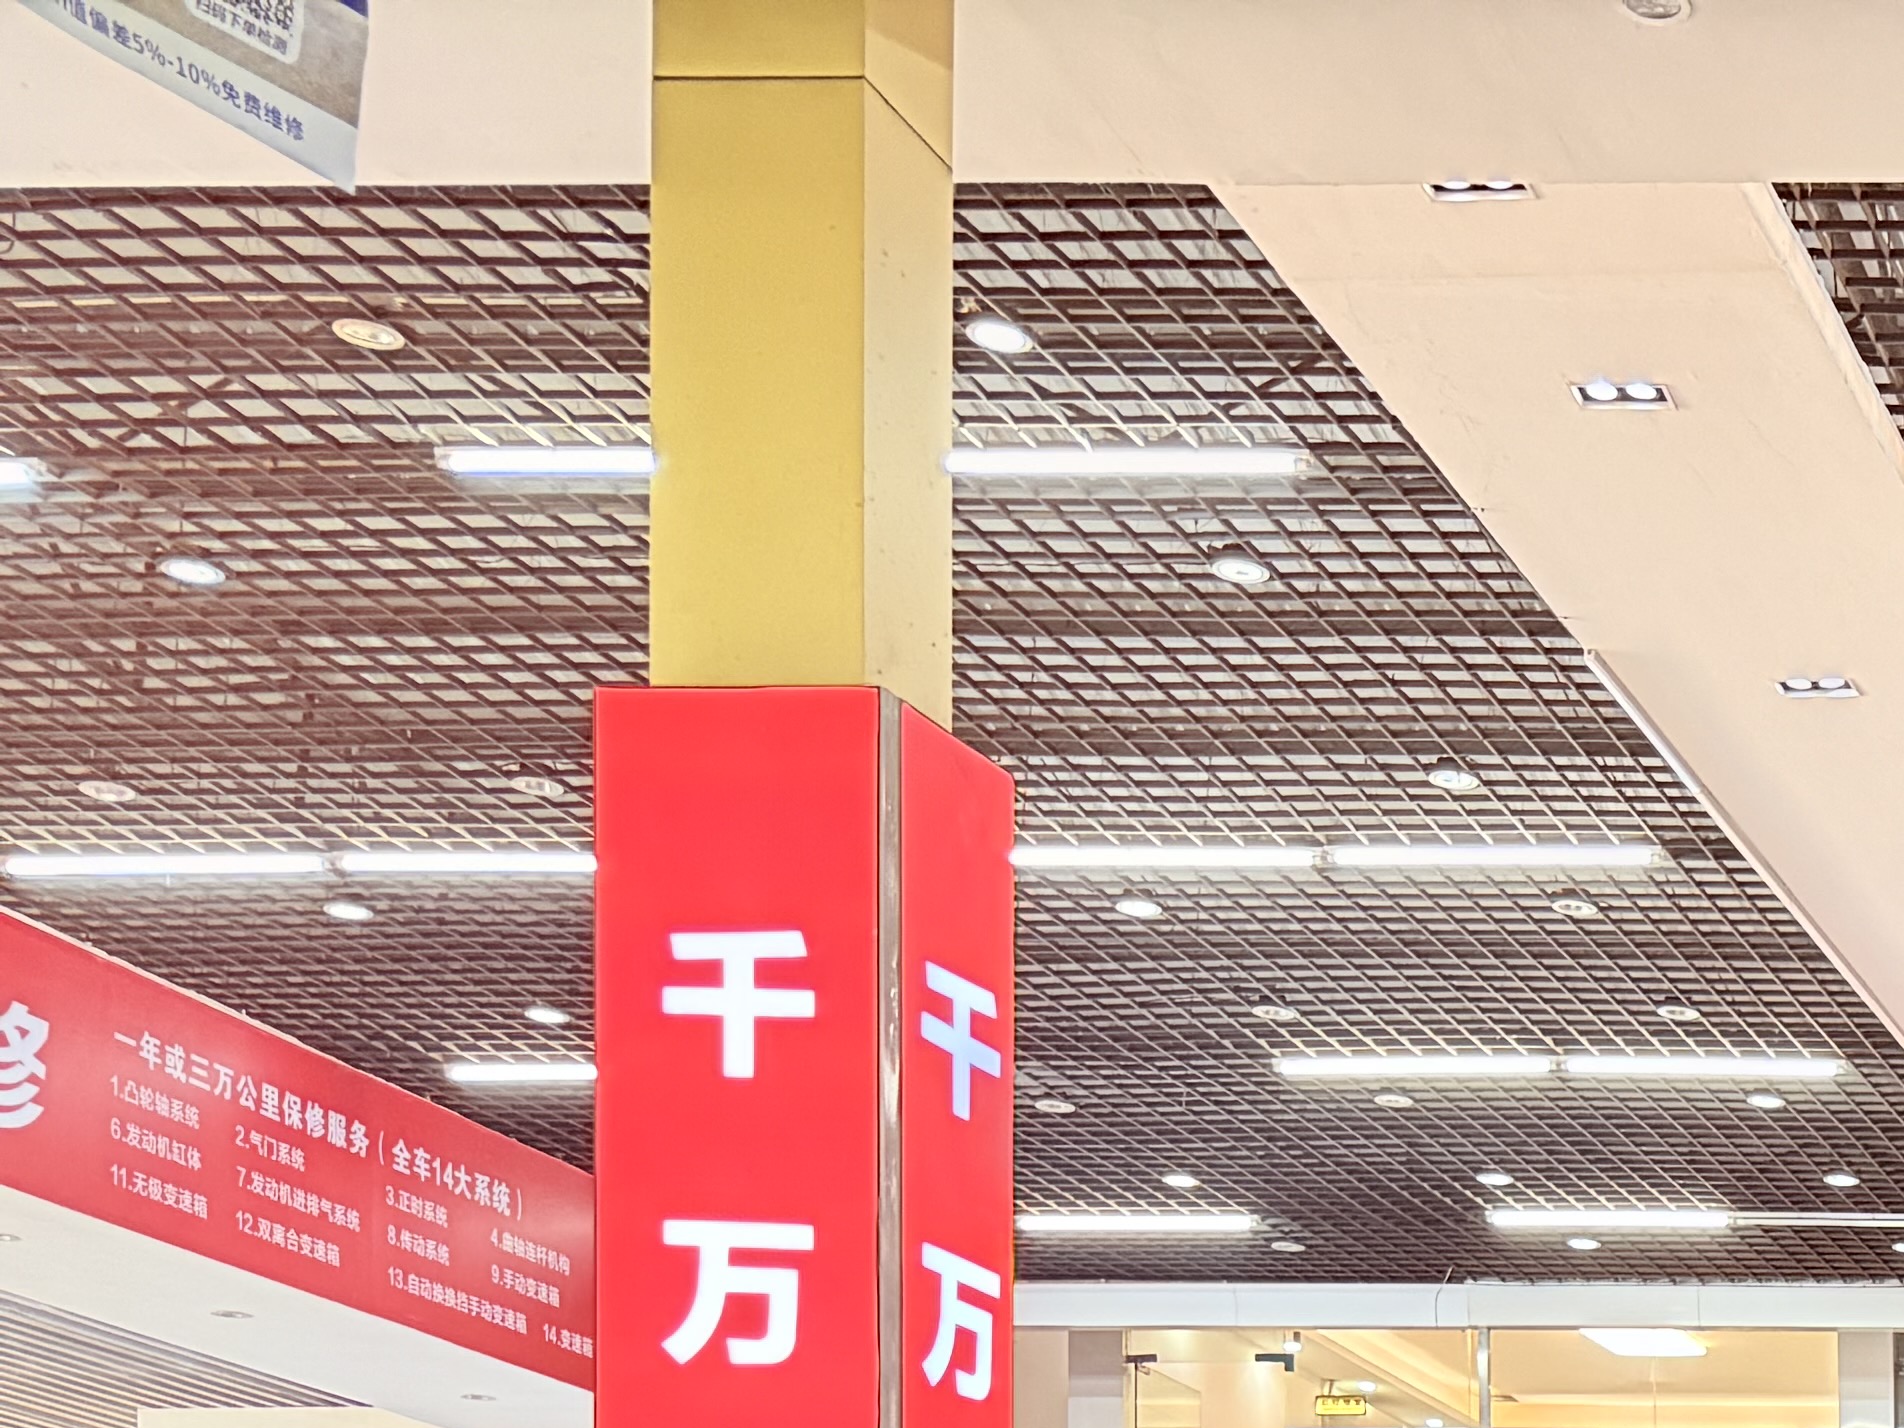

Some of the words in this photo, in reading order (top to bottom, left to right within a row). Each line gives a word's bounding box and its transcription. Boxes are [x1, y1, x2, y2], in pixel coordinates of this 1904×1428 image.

[54, 0, 304, 142] 值偏差5%-10%免费维修
[235, 1124, 305, 1172] 2.气门系统
[385, 1185, 449, 1229] 3.正时系统
